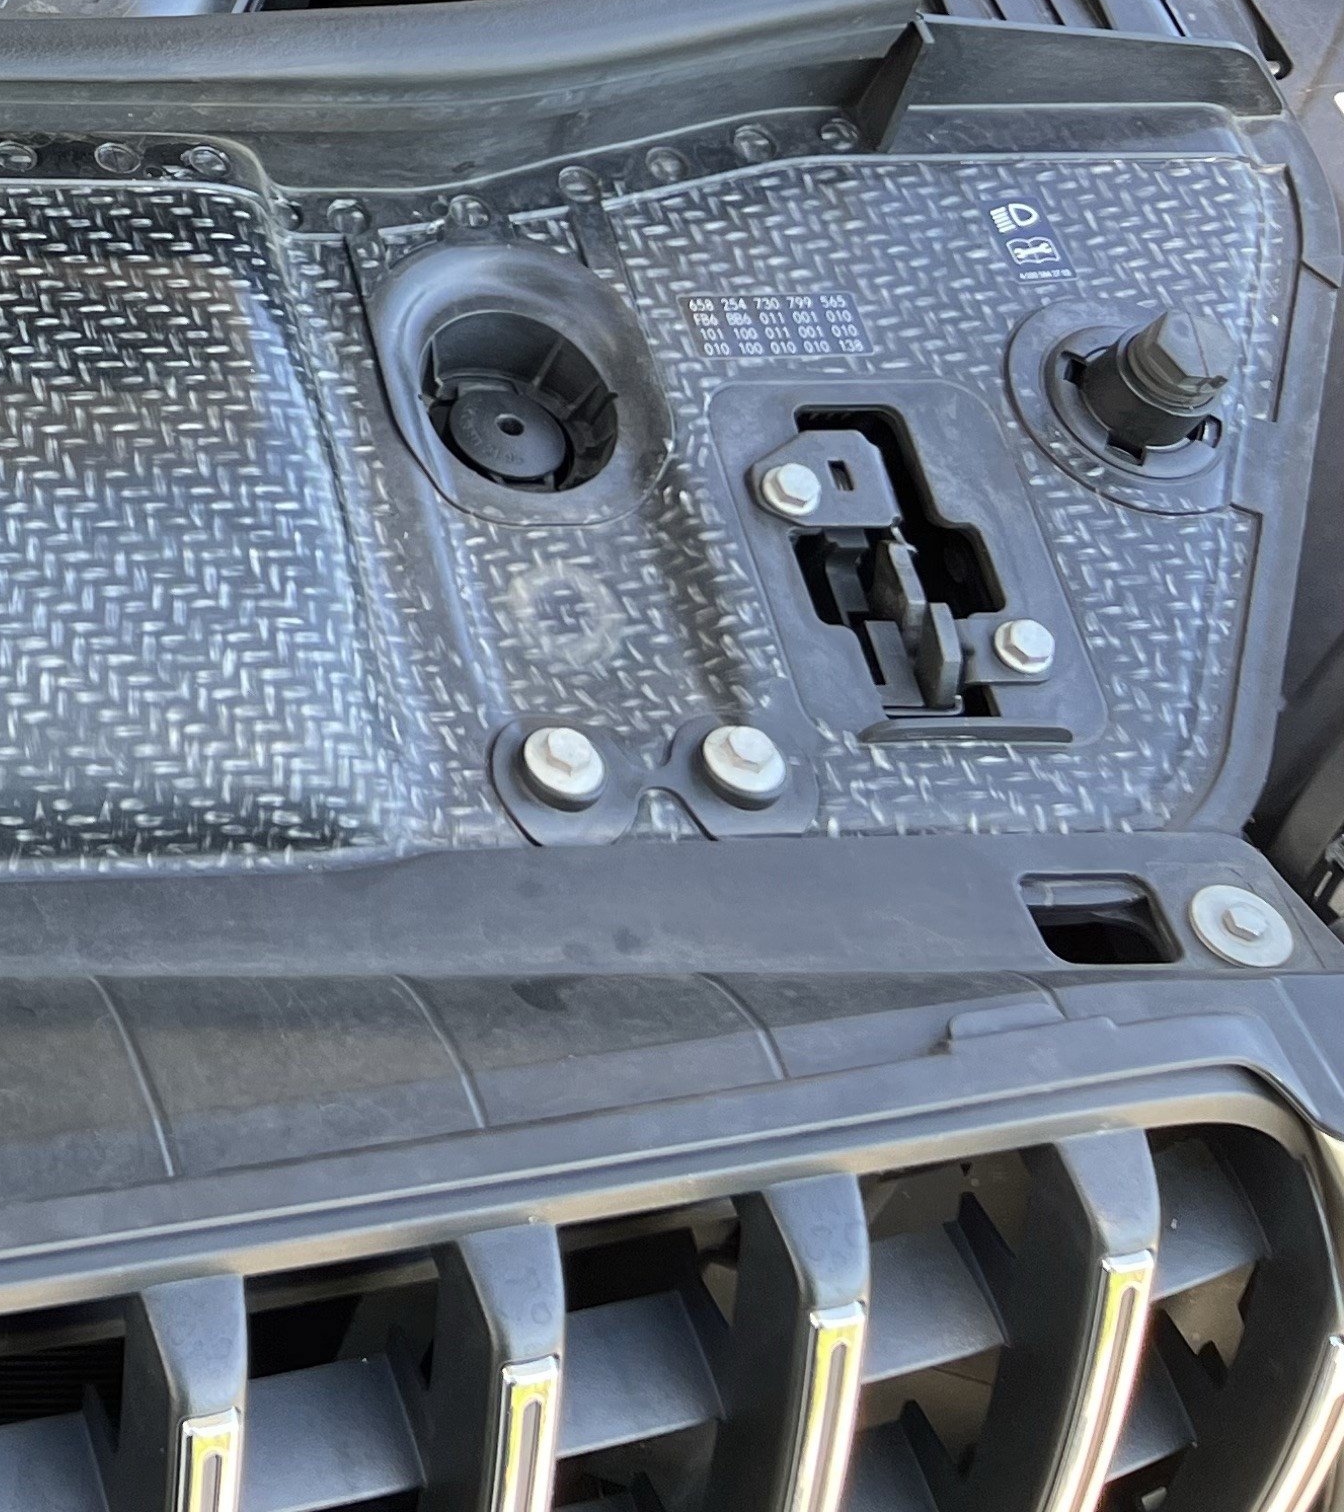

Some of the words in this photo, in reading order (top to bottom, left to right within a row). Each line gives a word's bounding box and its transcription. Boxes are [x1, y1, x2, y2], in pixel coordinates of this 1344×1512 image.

[689, 299, 714, 312] 658
[753, 297, 780, 310] 730
[786, 296, 812, 309] 799
[820, 295, 846, 308] 565
[759, 311, 785, 325] 011
[792, 311, 818, 324] 001
[825, 309, 852, 323] 010
[700, 328, 724, 341] 101
[733, 327, 759, 340] 100
[765, 326, 791, 339] 011
[798, 325, 824, 338] 001
[831, 324, 859, 337] 010
[703, 342, 730, 356] 010
[738, 341, 764, 355] 100
[770, 341, 797, 354] 010
[803, 340, 831, 353] 010
[838, 339, 864, 352] 138
